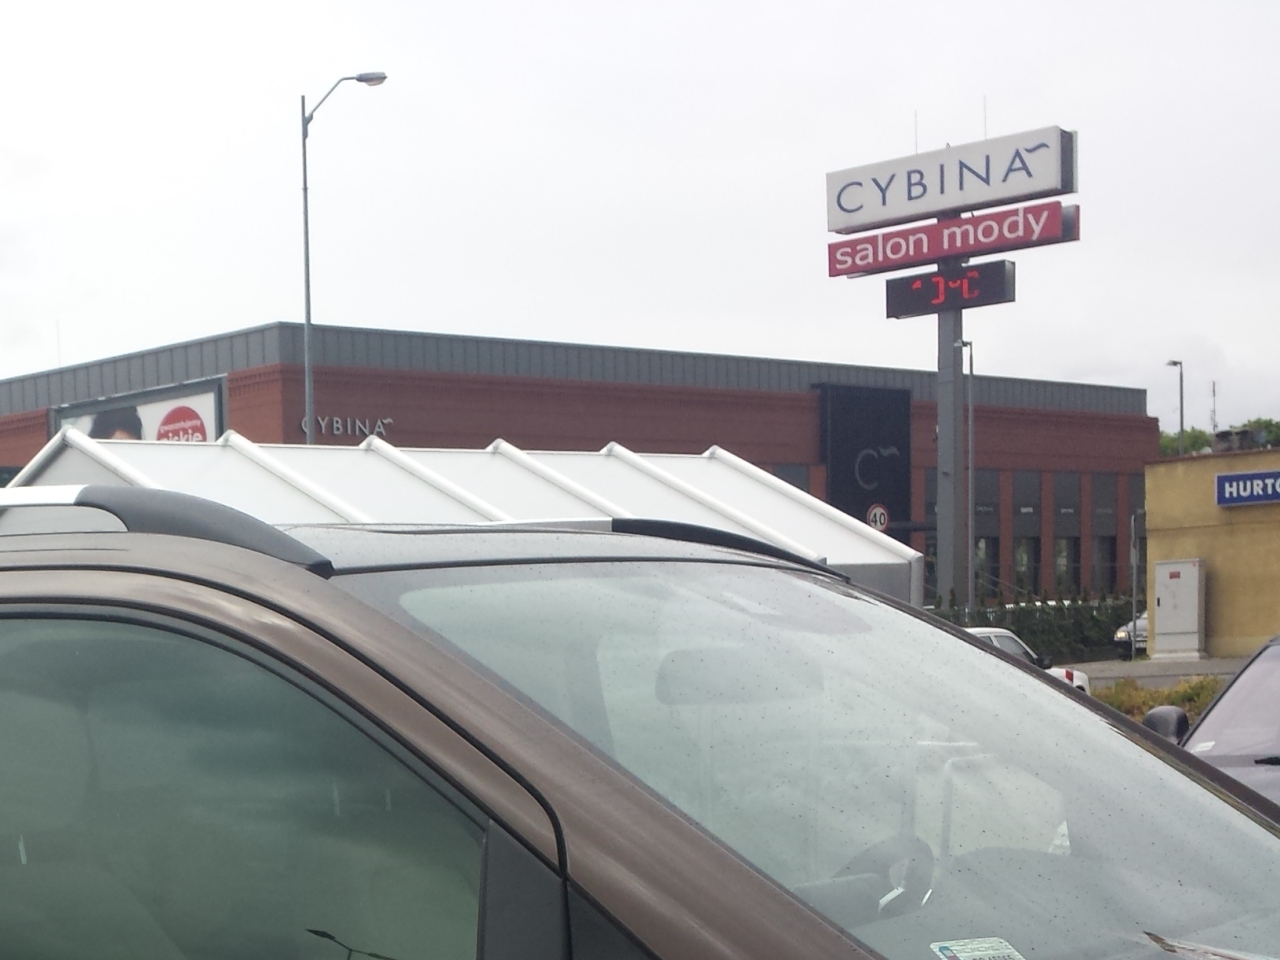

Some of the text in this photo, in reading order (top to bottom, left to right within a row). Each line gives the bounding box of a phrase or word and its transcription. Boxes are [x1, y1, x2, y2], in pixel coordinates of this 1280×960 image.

[836, 148, 1034, 213] CYBINA
[835, 207, 1049, 270] salon mody
[870, 512, 887, 527] 40
